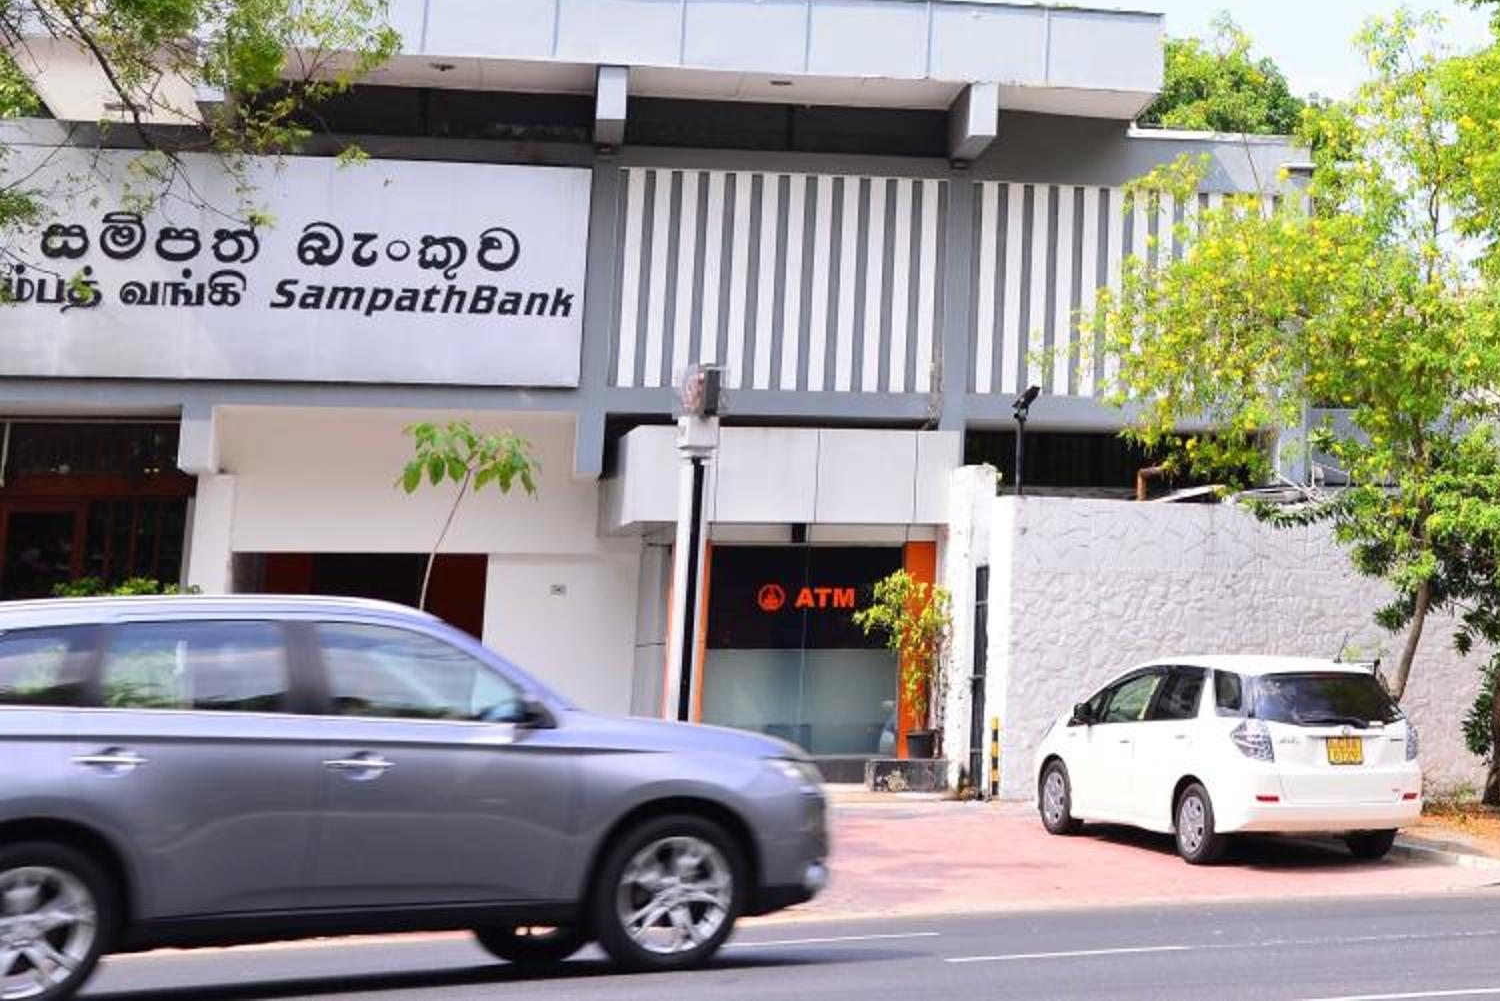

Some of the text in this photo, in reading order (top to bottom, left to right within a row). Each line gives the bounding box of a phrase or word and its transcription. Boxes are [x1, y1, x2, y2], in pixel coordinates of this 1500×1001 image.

[297, 221, 521, 281] බැංකුව
[0, 264, 247, 313] ம்பத் வங்கி
[269, 278, 574, 318] SampathBank
[795, 587, 855, 608] ATM
